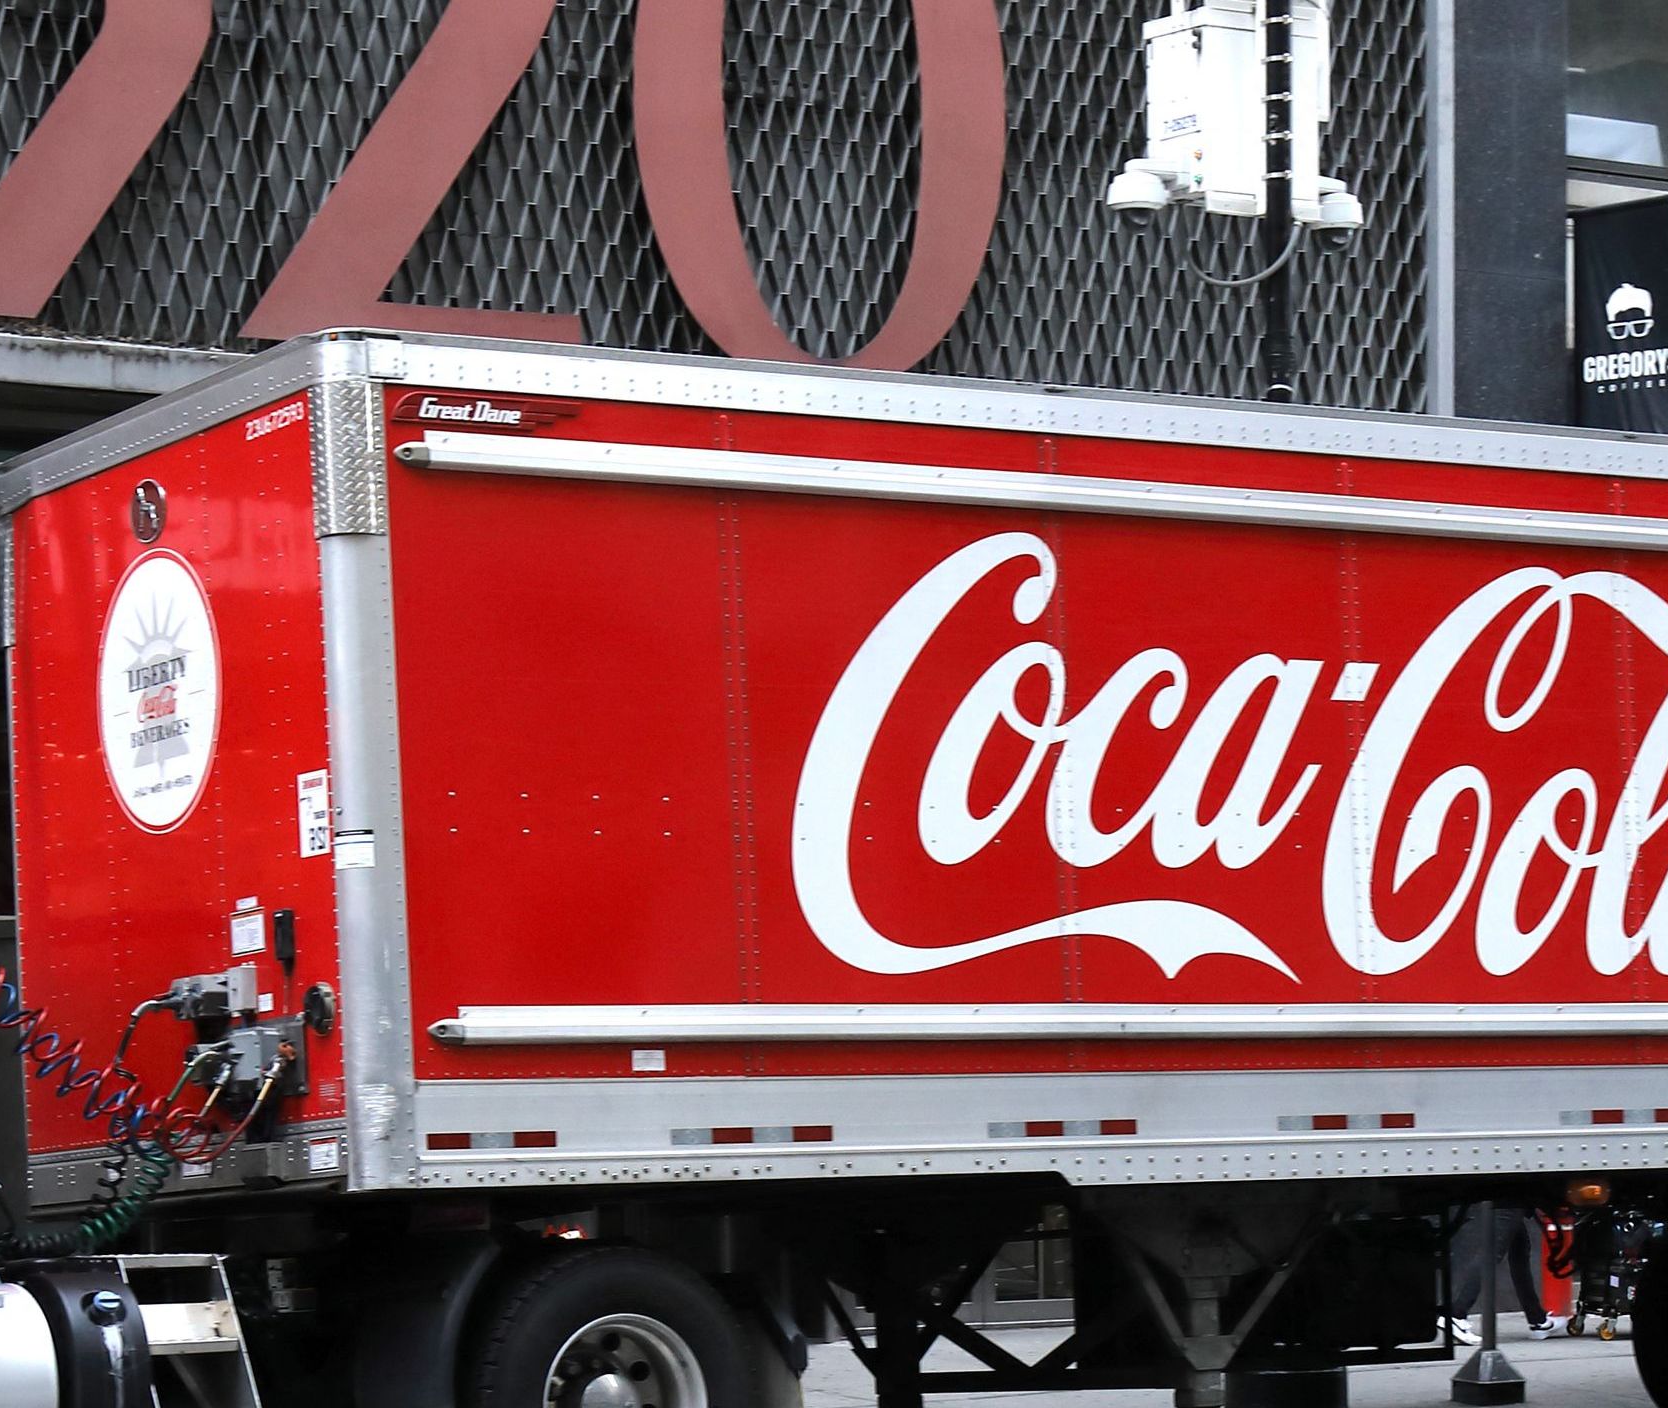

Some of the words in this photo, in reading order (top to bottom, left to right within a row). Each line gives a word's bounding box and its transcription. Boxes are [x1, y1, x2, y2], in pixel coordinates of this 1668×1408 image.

[1597, 379, 1666, 393] COFFEE
[419, 397, 474, 421] Great
[473, 401, 522, 425] Dane
[128, 655, 186, 693] LIBERTY
